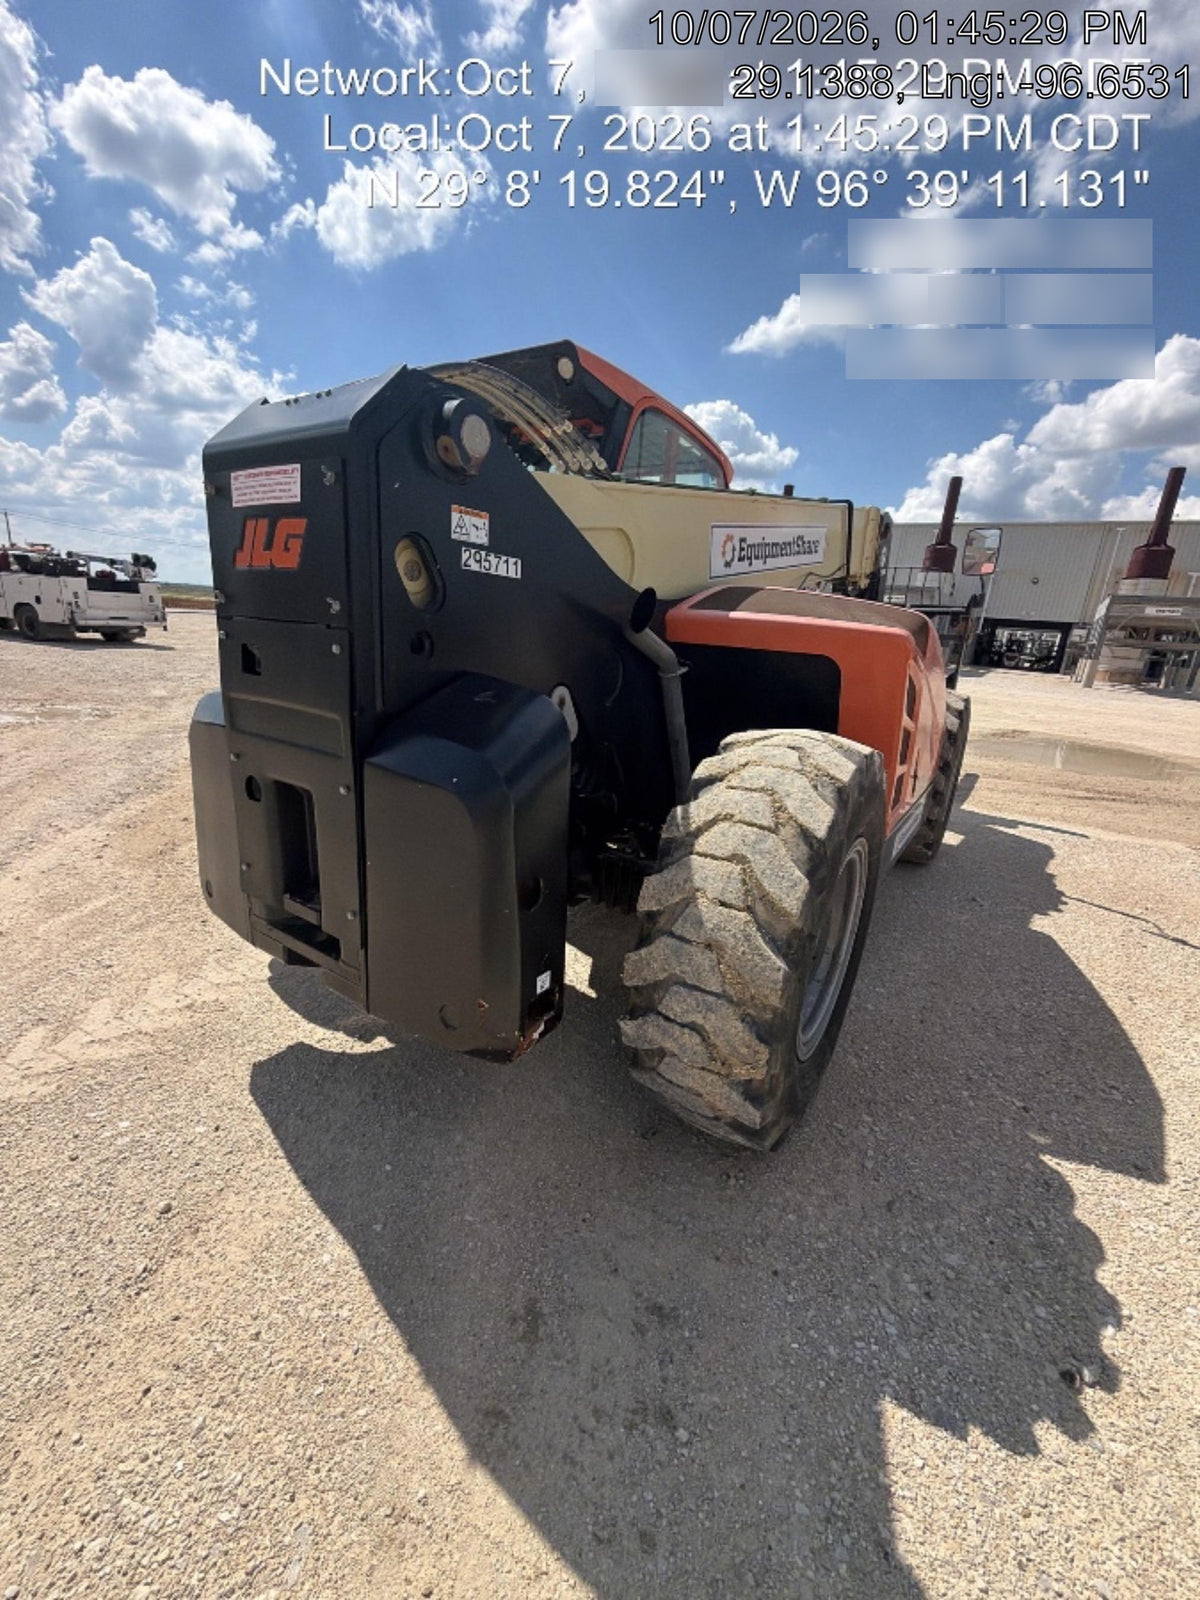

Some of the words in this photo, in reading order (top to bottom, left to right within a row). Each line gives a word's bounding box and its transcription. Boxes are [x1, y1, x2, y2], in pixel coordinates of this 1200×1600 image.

[234, 517, 308, 570] JLG
[737, 534, 820, 566] EquipmentShare
[463, 548, 519, 577] 295711
